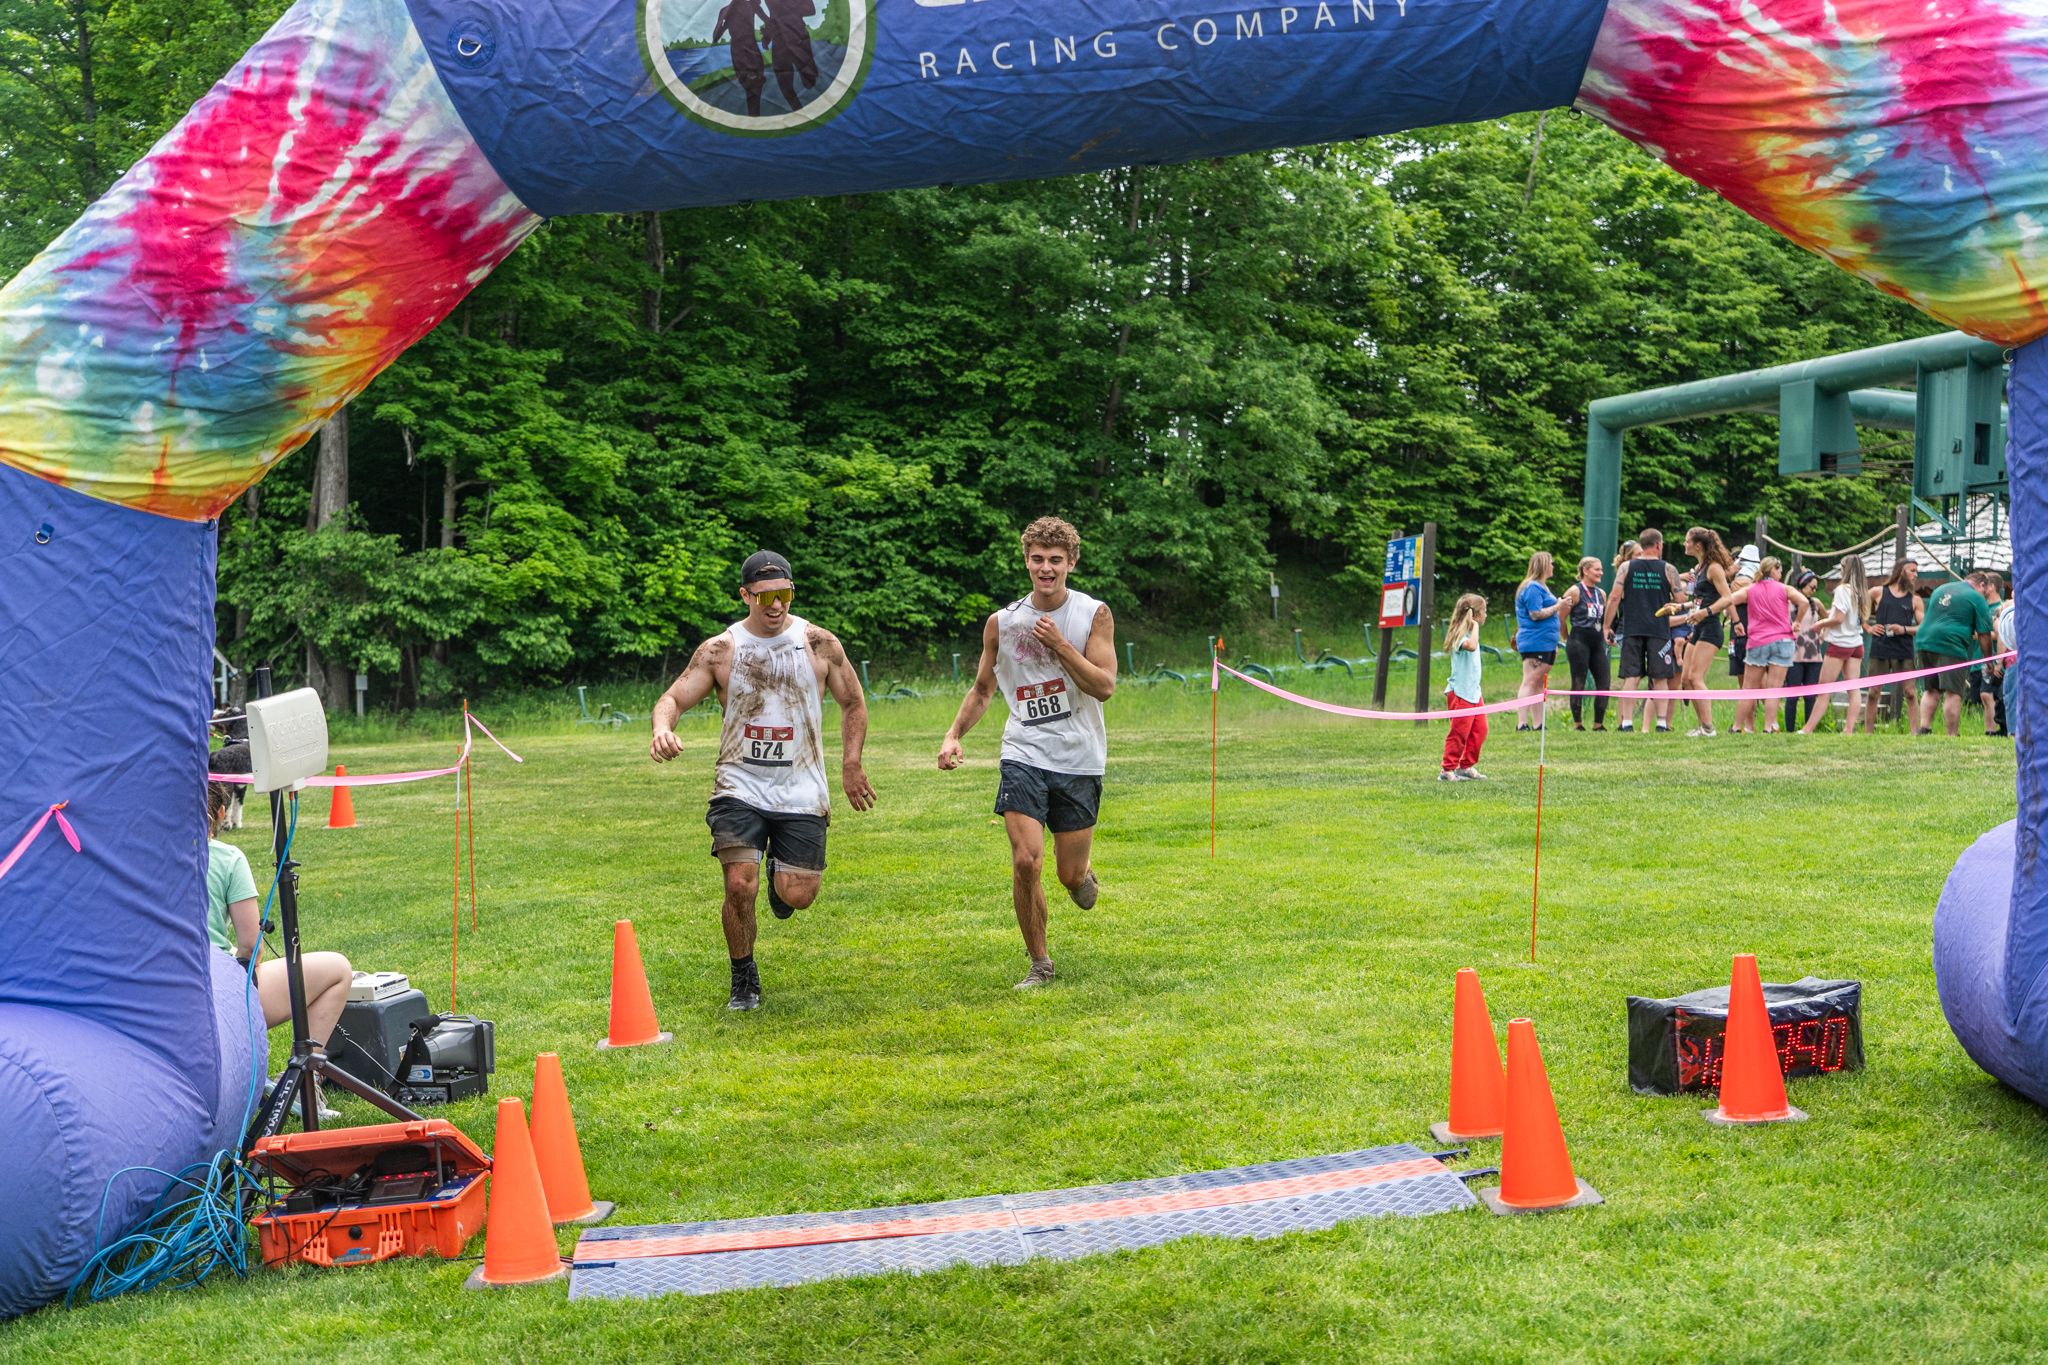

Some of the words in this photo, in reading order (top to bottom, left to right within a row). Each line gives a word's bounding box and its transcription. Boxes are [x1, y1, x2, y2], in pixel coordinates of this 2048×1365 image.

[919, 31, 1117, 79] RACING
[1157, 0, 1413, 50] COMPANY
[1027, 695, 1061, 718] 668
[751, 741, 784, 759] 674
